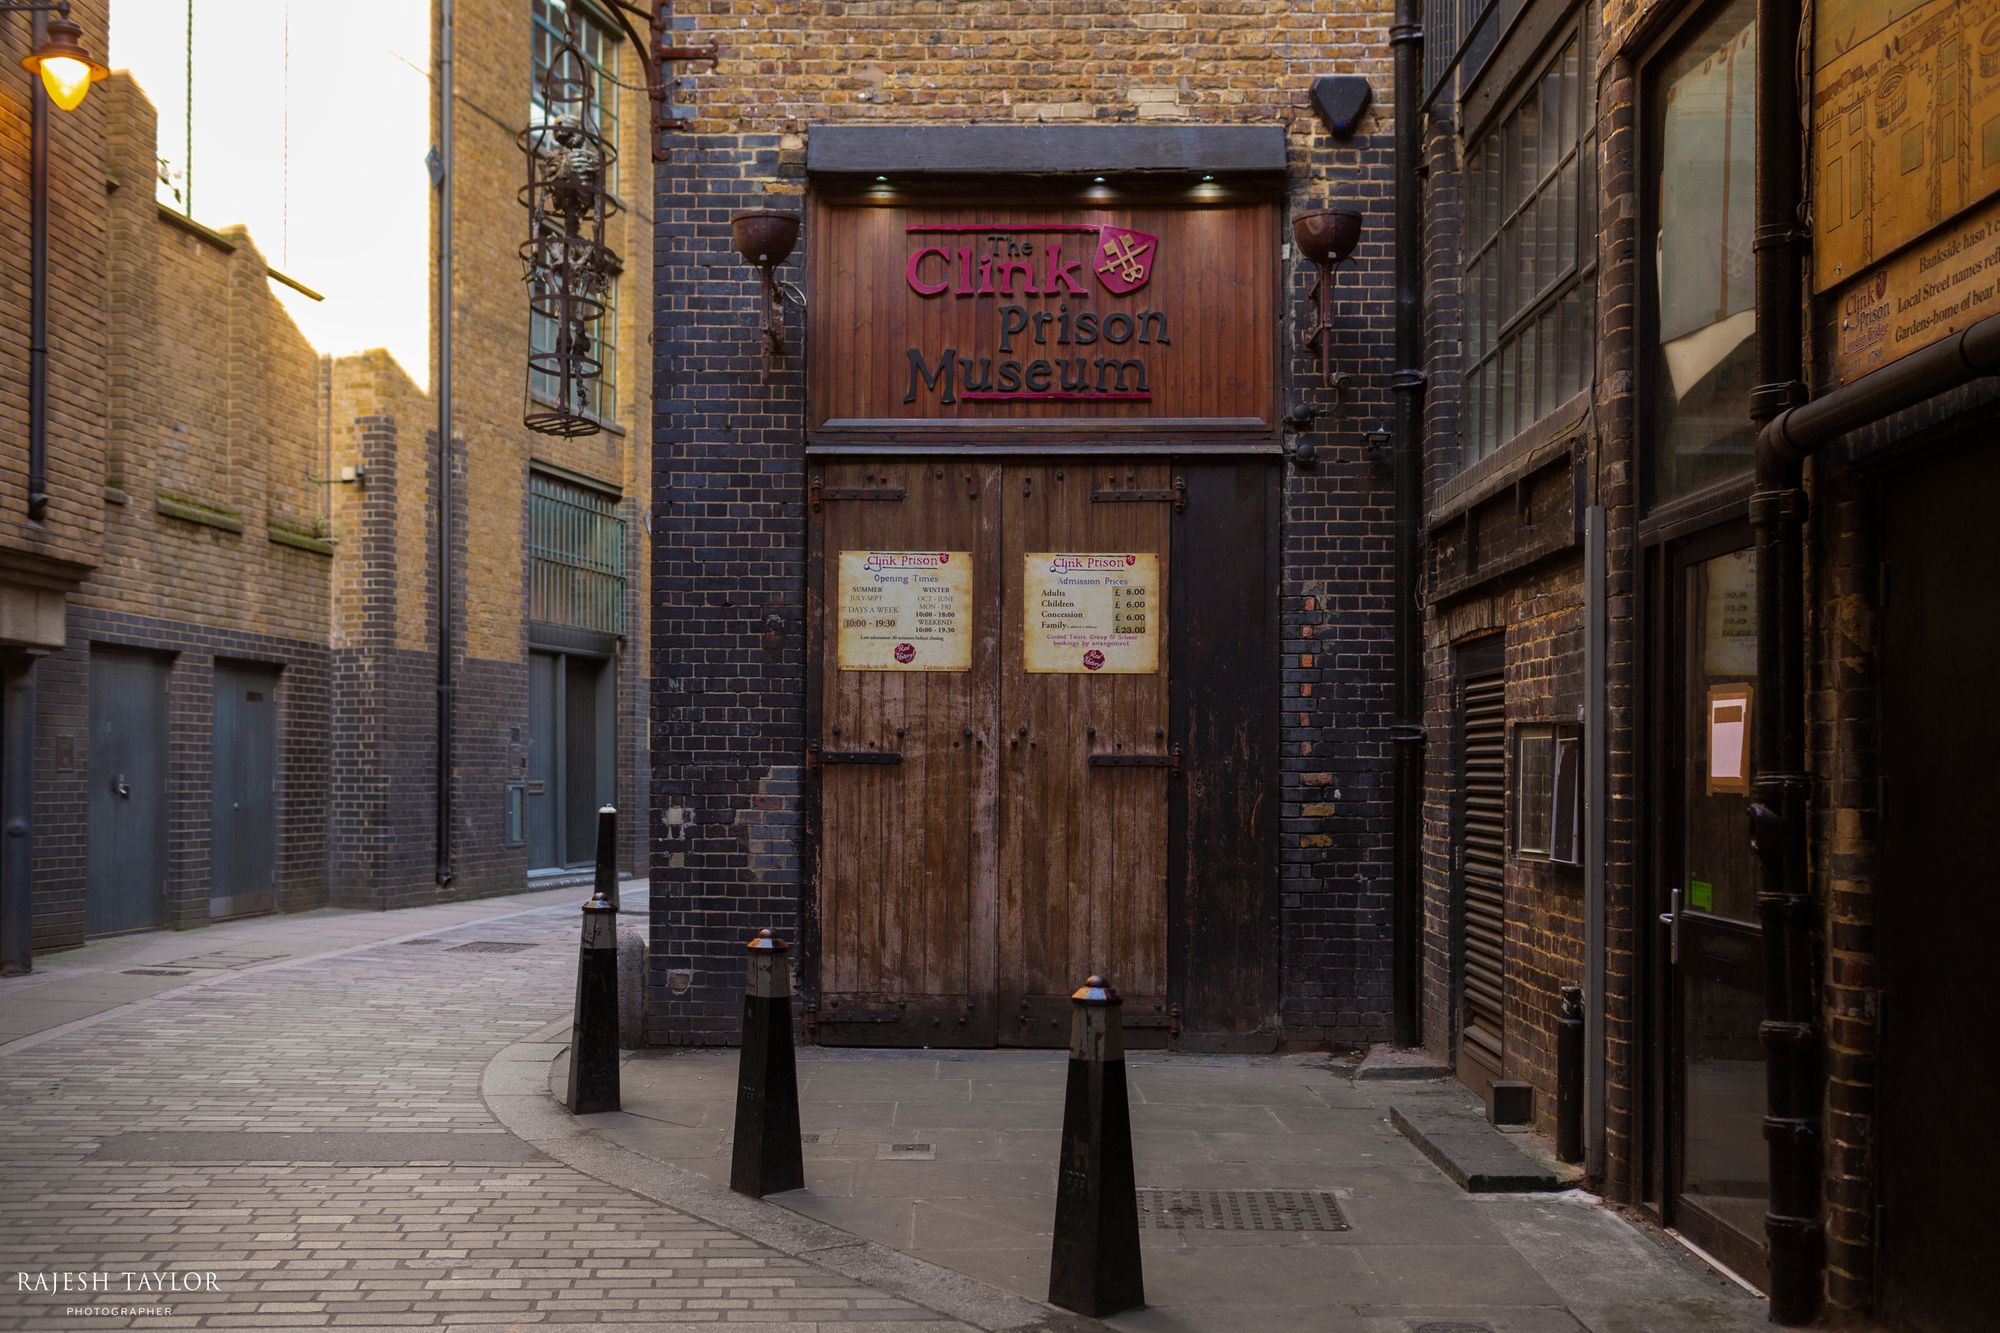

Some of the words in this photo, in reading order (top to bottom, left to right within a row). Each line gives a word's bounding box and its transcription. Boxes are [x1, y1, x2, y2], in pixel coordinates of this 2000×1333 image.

[989, 236, 1033, 257] The
[1919, 238, 1962, 274] Bankside
[1963, 221, 1992, 252] hasn't
[906, 245, 1088, 296] Clink
[1898, 288, 1923, 314] Local
[1923, 274, 1951, 301] Street
[1952, 263, 1982, 291] names
[1845, 285, 1875, 316] Clink
[1895, 306, 1958, 343] Gardens-home
[1960, 291, 1971, 313] of
[1972, 285, 1994, 309] bear
[998, 303, 1170, 353] Prison
[902, 347, 1152, 404] Museum
[867, 556, 896, 567] Clink
[902, 555, 938, 566] Prison
[874, 574, 908, 584] Opening
[913, 575, 938, 583] Times
[1053, 557, 1082, 569] Clink
[1088, 558, 1124, 568] Prison
[875, 620, 896, 628] 19:30
